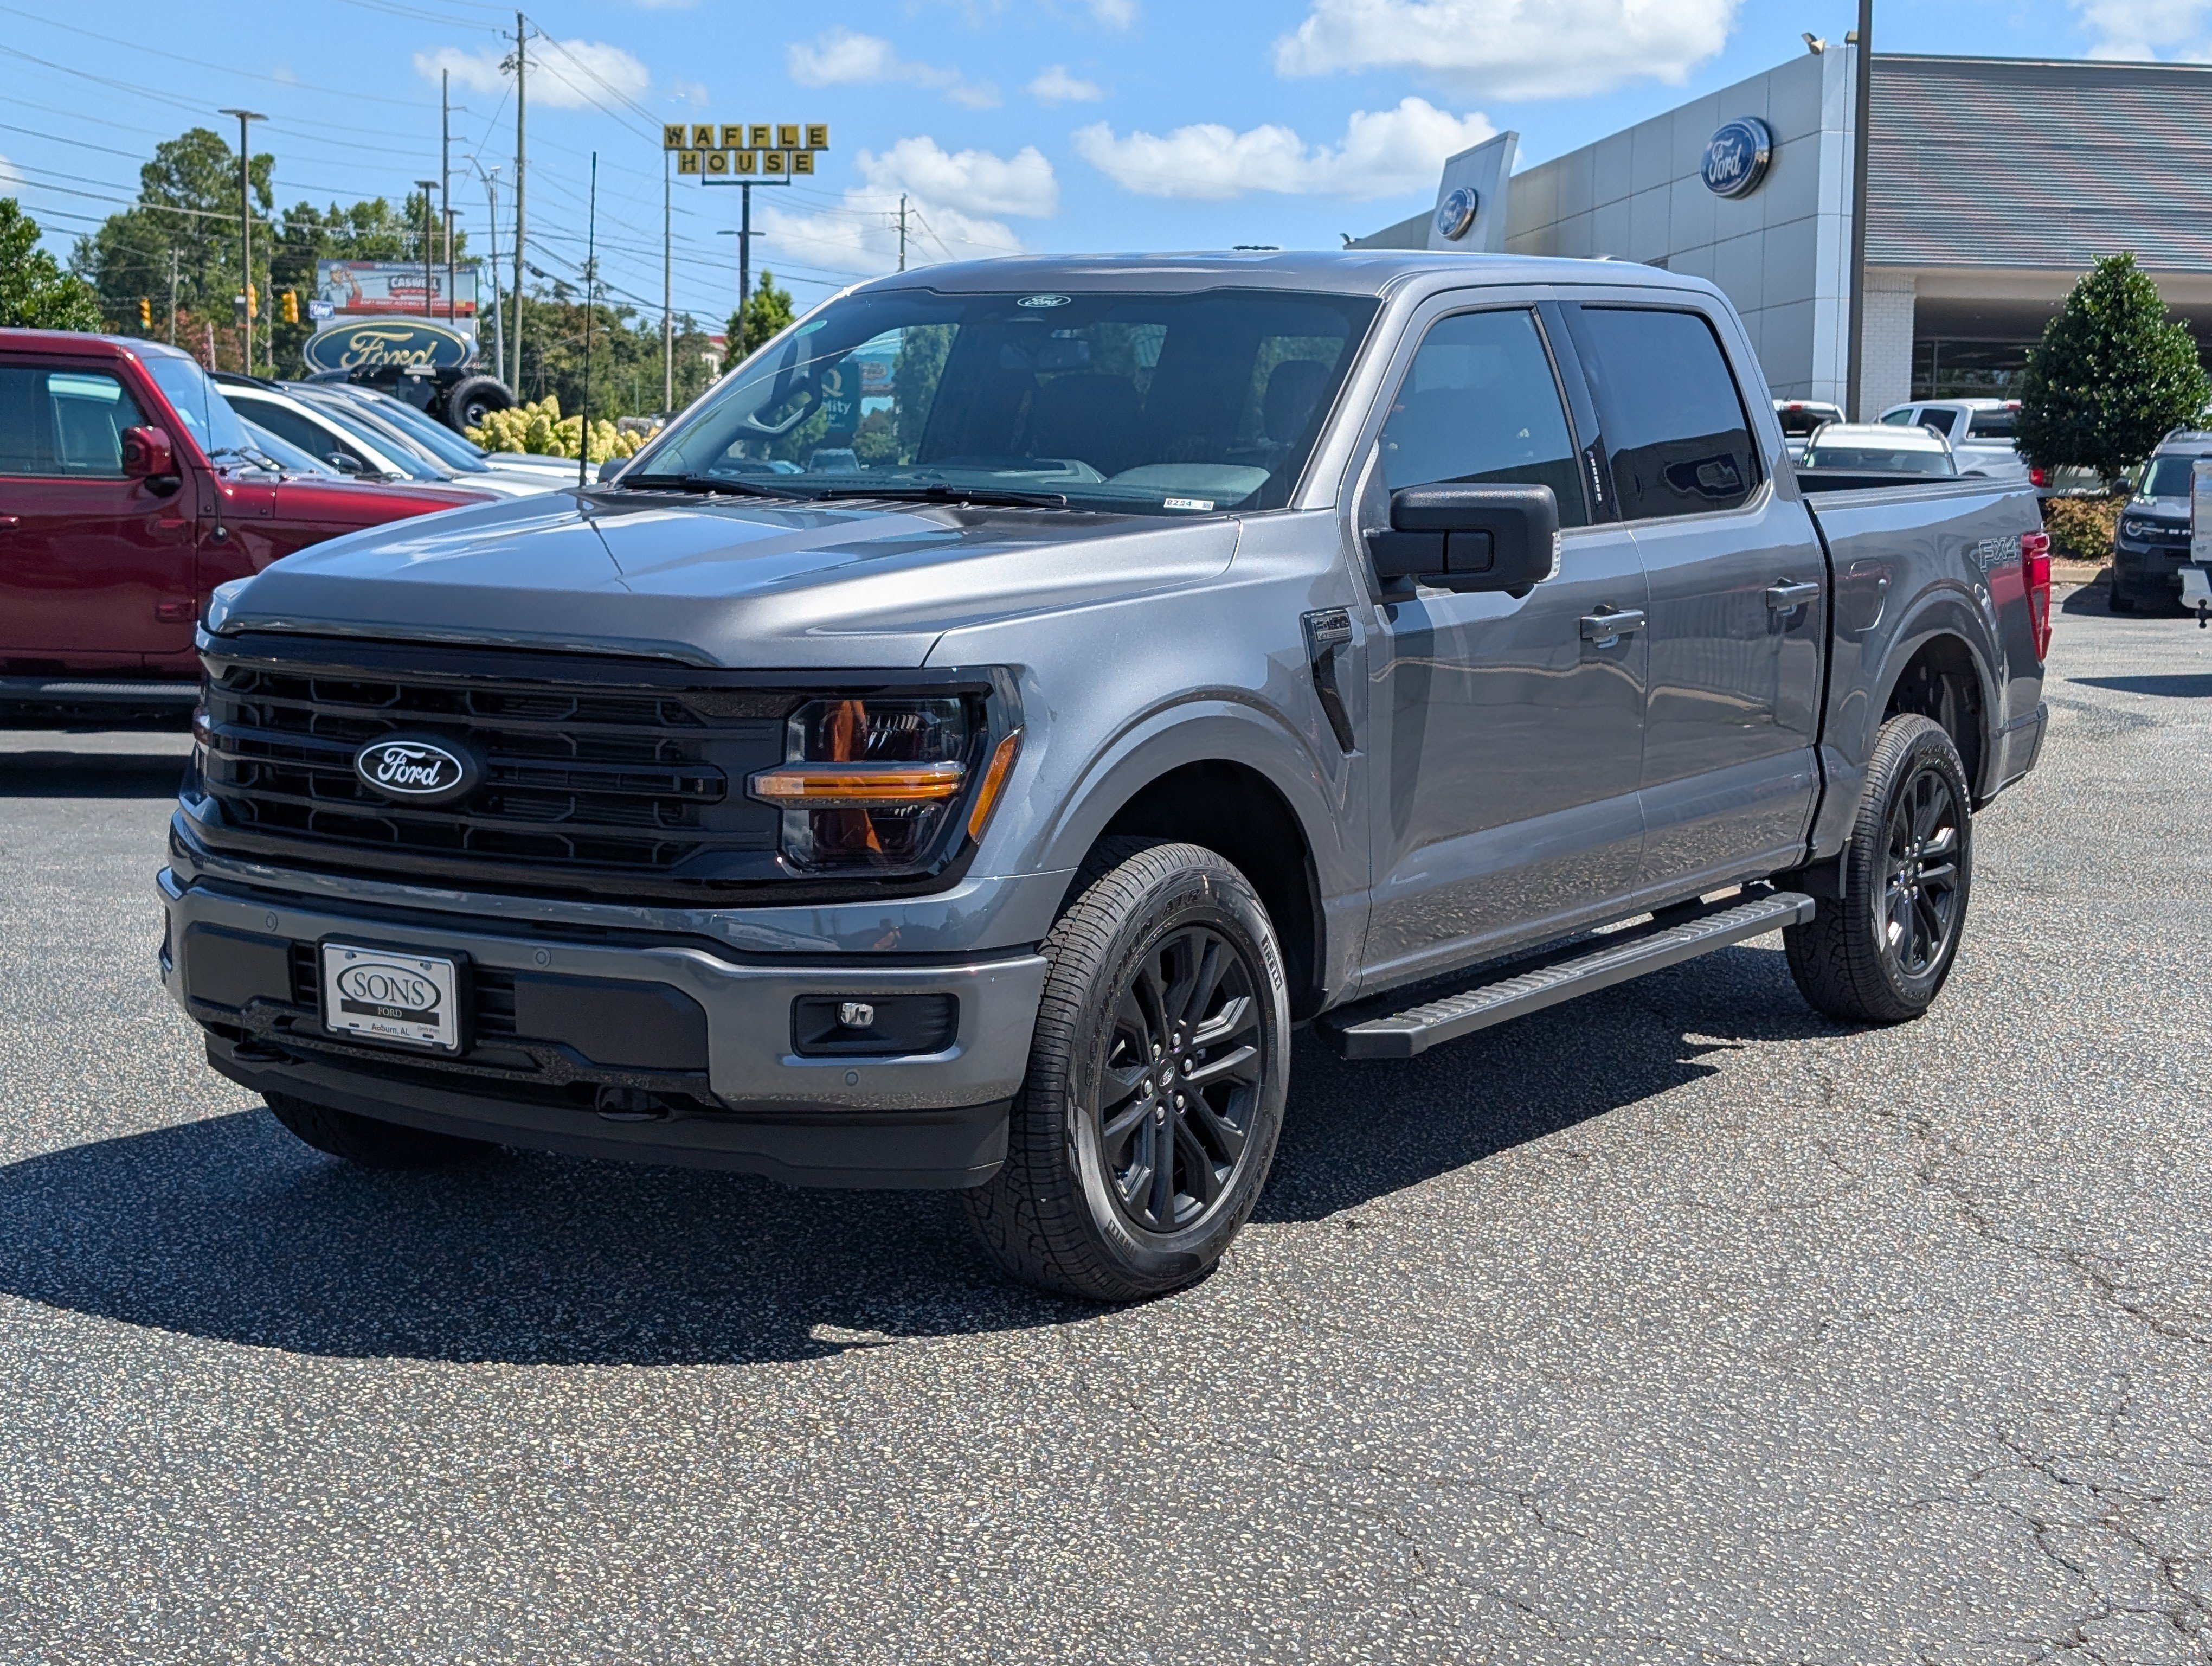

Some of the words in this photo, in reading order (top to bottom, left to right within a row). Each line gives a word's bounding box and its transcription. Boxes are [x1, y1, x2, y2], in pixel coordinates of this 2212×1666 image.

[667, 127, 824, 145] WAFFLE
[681, 153, 809, 172] HOUSE
[1708, 137, 1742, 183] Ford
[1025, 297, 1063, 305] Ford
[340, 331, 438, 366] Ford
[1978, 536, 2019, 573] FX4
[377, 747, 441, 786] Ford
[1261, 933, 1283, 991] PIRELLI
[353, 972, 425, 1006] SONS
[371, 1022, 399, 1036] Auburn,
[400, 1026, 410, 1036] AL
[377, 1006, 402, 1018] FORD
